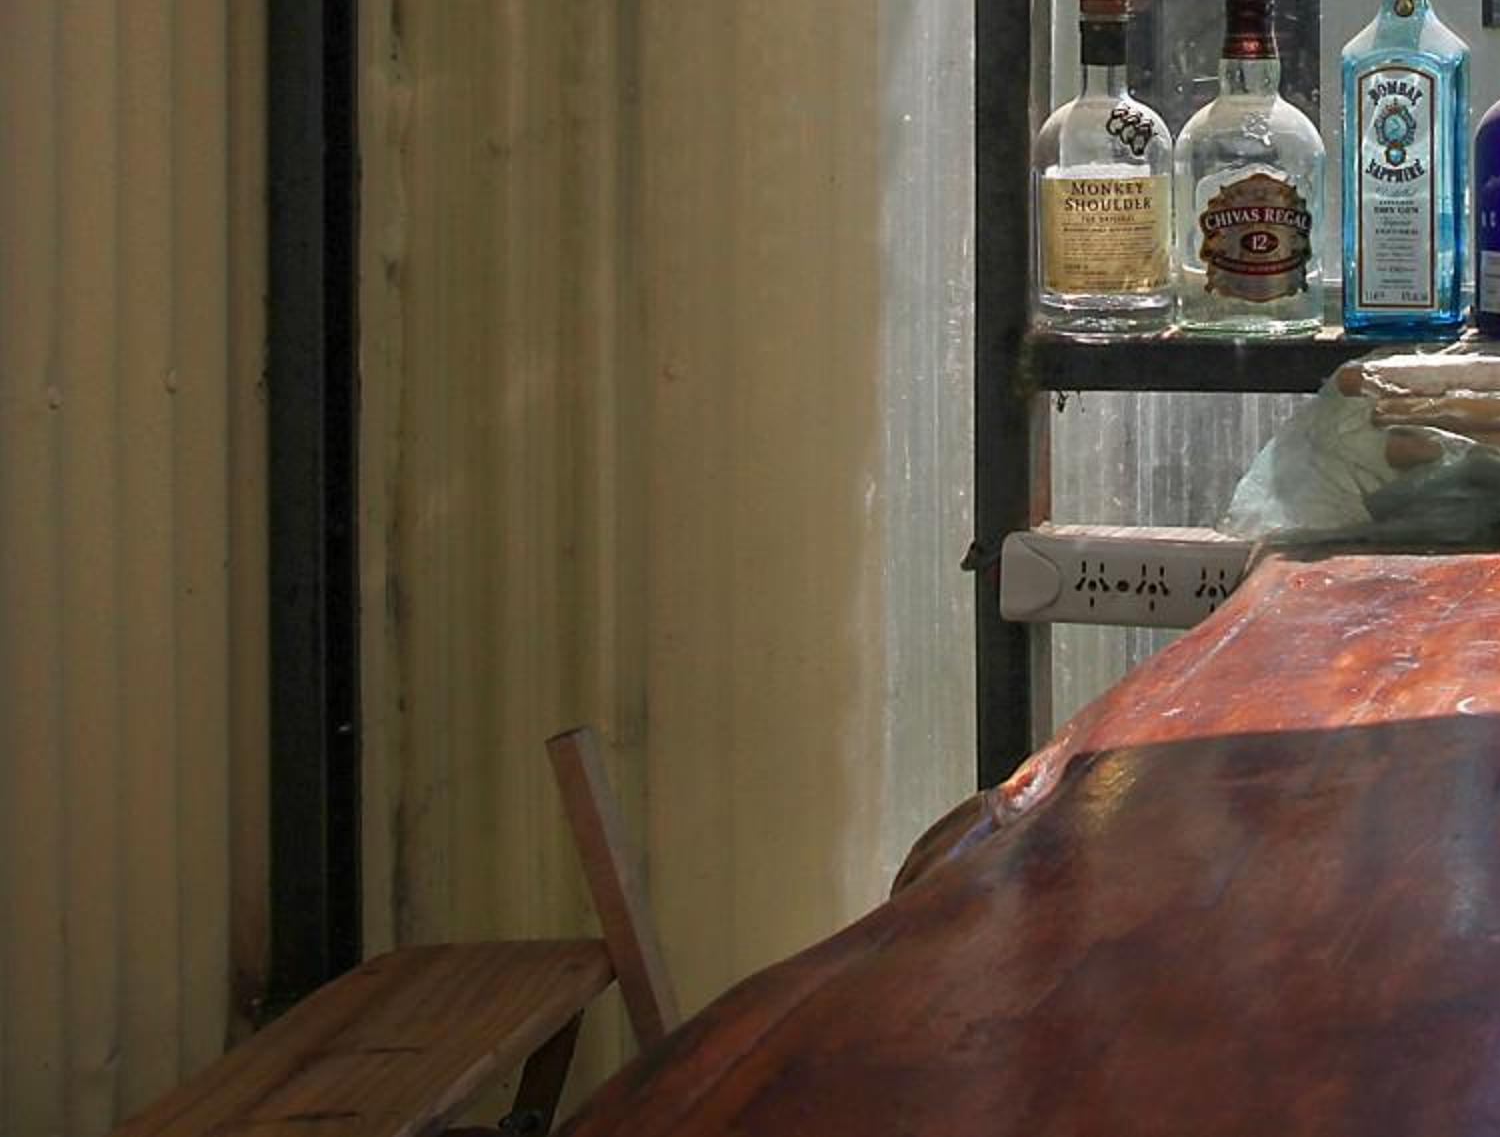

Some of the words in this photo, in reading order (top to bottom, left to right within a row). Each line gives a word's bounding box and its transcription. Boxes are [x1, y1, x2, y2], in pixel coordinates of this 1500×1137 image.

[1368, 80, 1423, 106] BOMBAY
[1071, 181, 1145, 196] MONKEY
[1063, 197, 1153, 212] SHOULDER
[1204, 207, 1261, 231] CHIVAS
[1263, 207, 1311, 230] REGAL
[1251, 233, 1269, 251] 12
